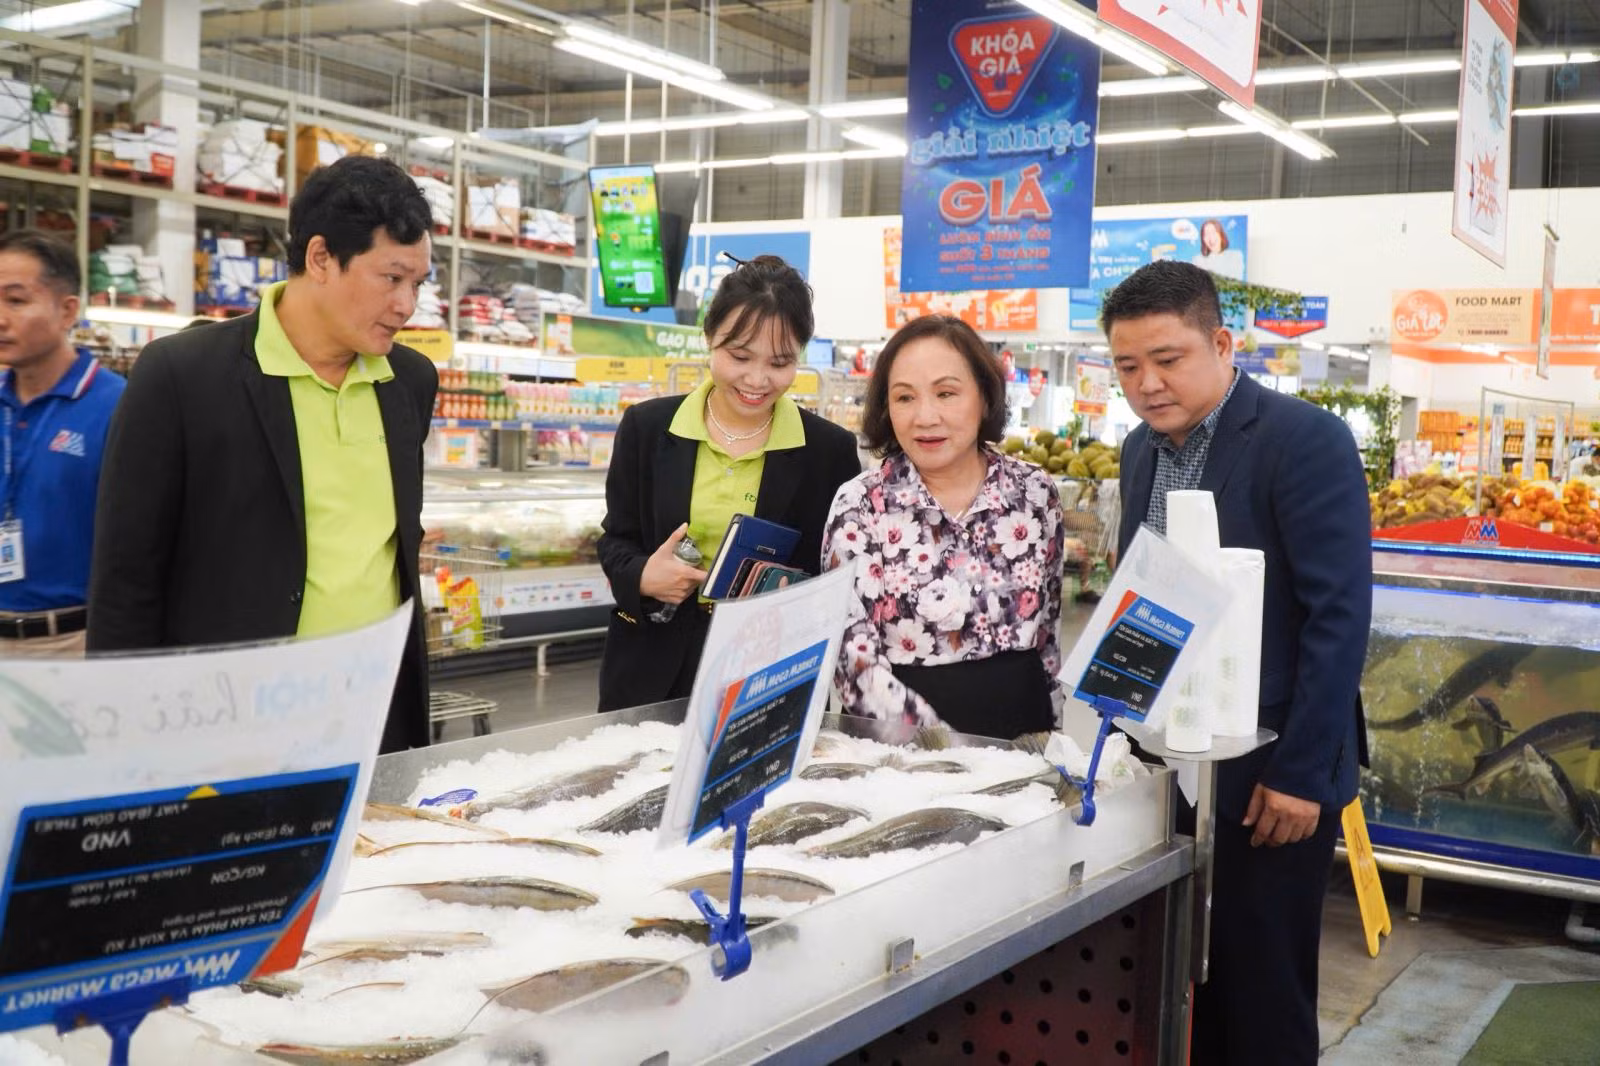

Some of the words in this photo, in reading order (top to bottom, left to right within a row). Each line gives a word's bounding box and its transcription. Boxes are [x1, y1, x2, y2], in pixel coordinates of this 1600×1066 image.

[970, 26, 1035, 57] KHÓA
[911, 126, 978, 166] giải
[987, 119, 1091, 156] nhiệt
[938, 163, 1053, 226] GIÁ
[1455, 296, 1489, 307] FOOD
[1491, 295, 1523, 306] MART
[220, 830, 242, 848] kg)
[243, 825, 277, 843] (Each
